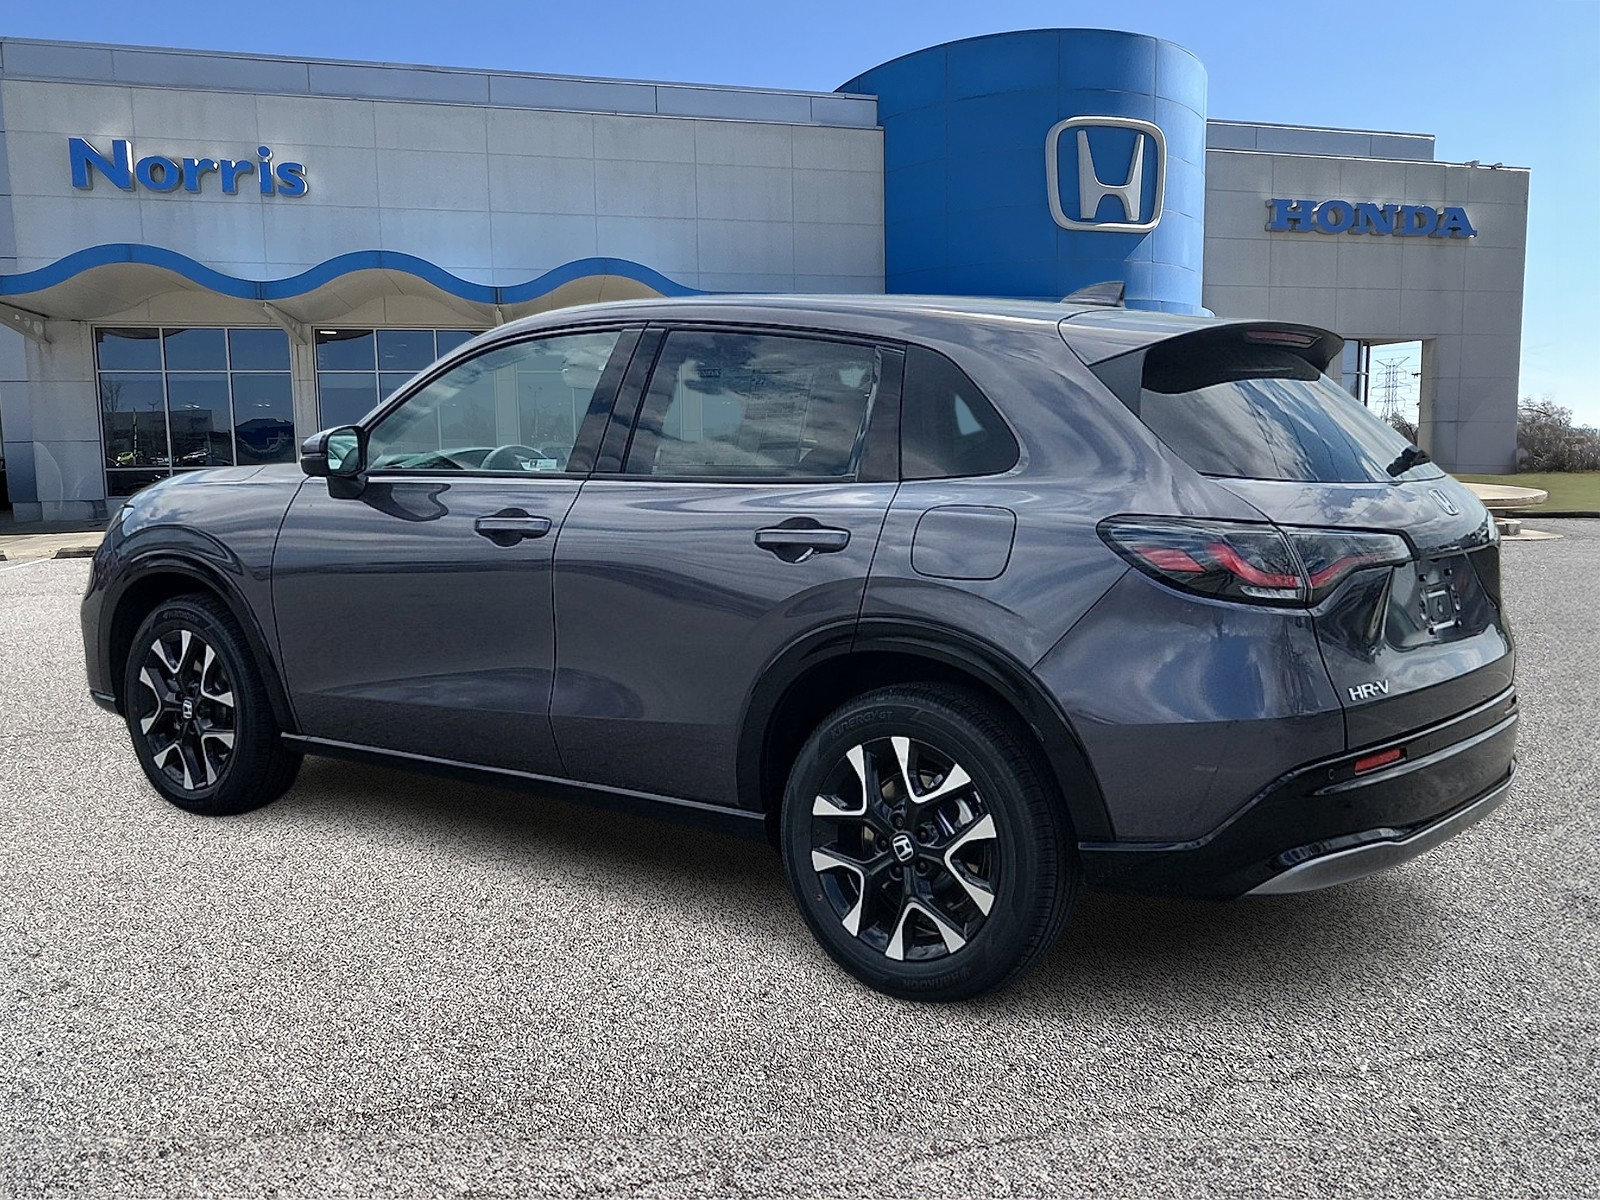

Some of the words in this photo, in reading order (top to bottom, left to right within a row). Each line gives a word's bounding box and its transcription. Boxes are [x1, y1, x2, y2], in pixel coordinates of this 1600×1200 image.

[68, 137, 308, 197] Norris
[1265, 198, 1478, 239] HONDA
[1348, 679, 1389, 701] HR-V
